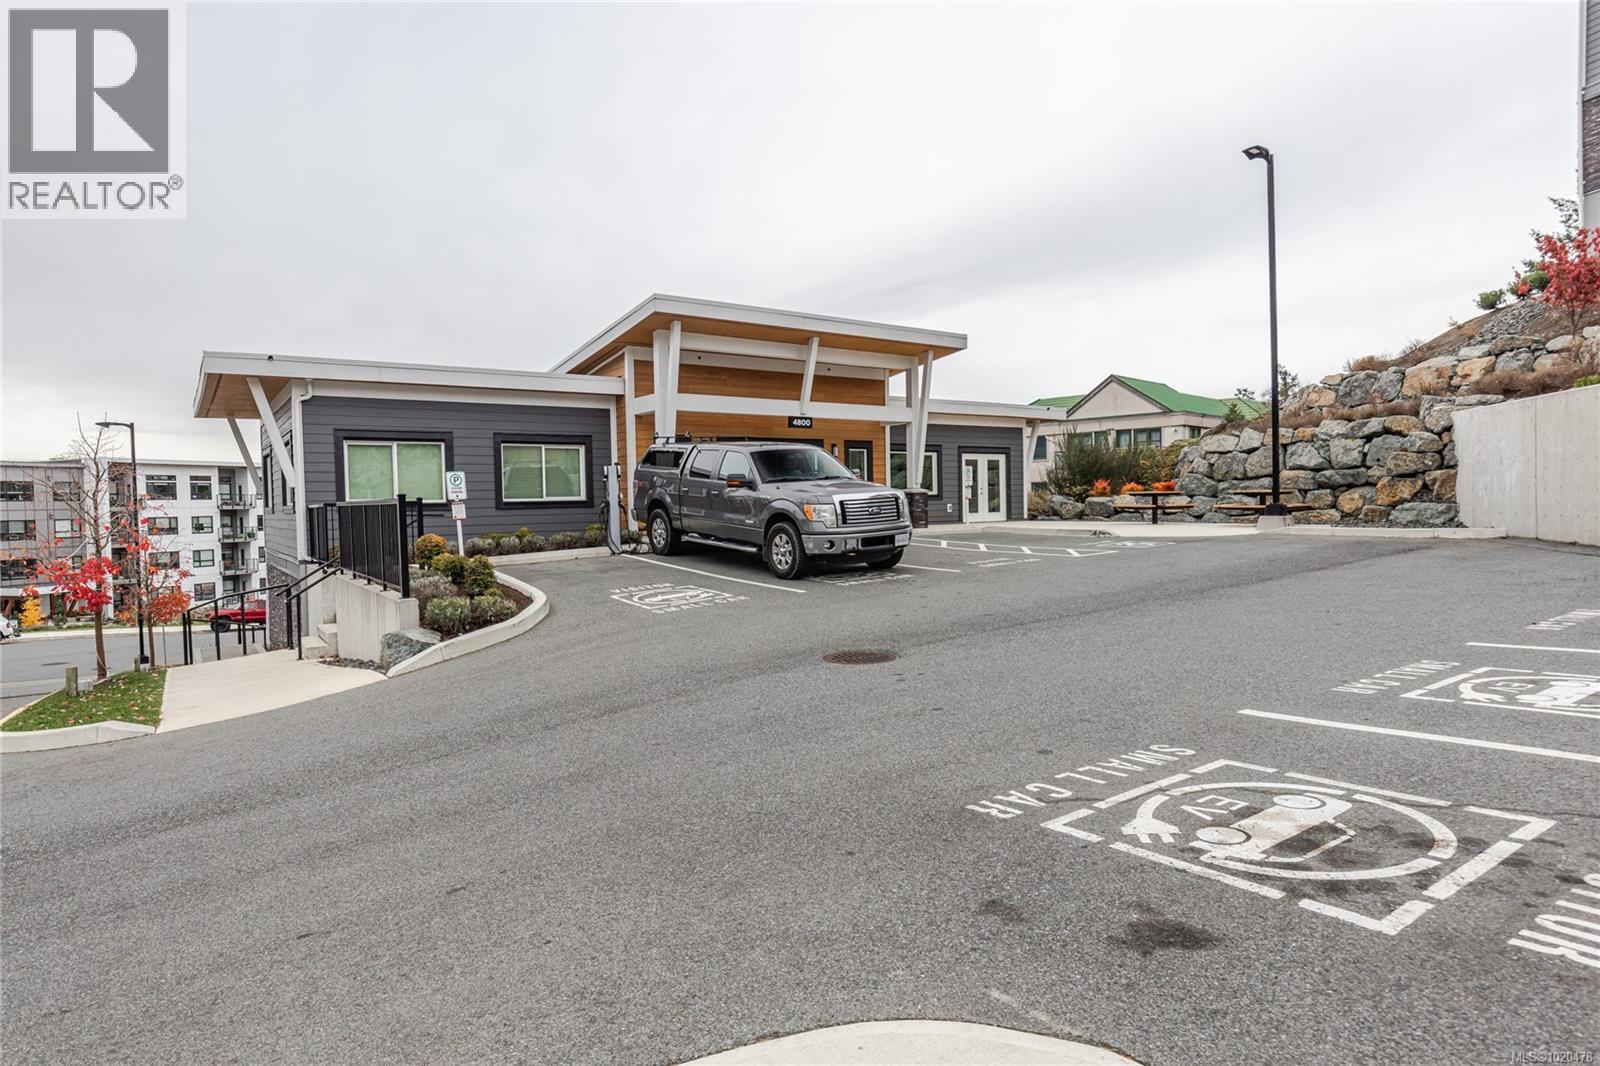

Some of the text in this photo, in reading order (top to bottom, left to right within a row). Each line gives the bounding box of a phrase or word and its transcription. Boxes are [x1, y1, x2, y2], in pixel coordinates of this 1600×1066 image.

[792, 418, 811, 427] 4800
[965, 744, 1196, 819] SMALL CAR
[1180, 794, 1250, 821] EV
